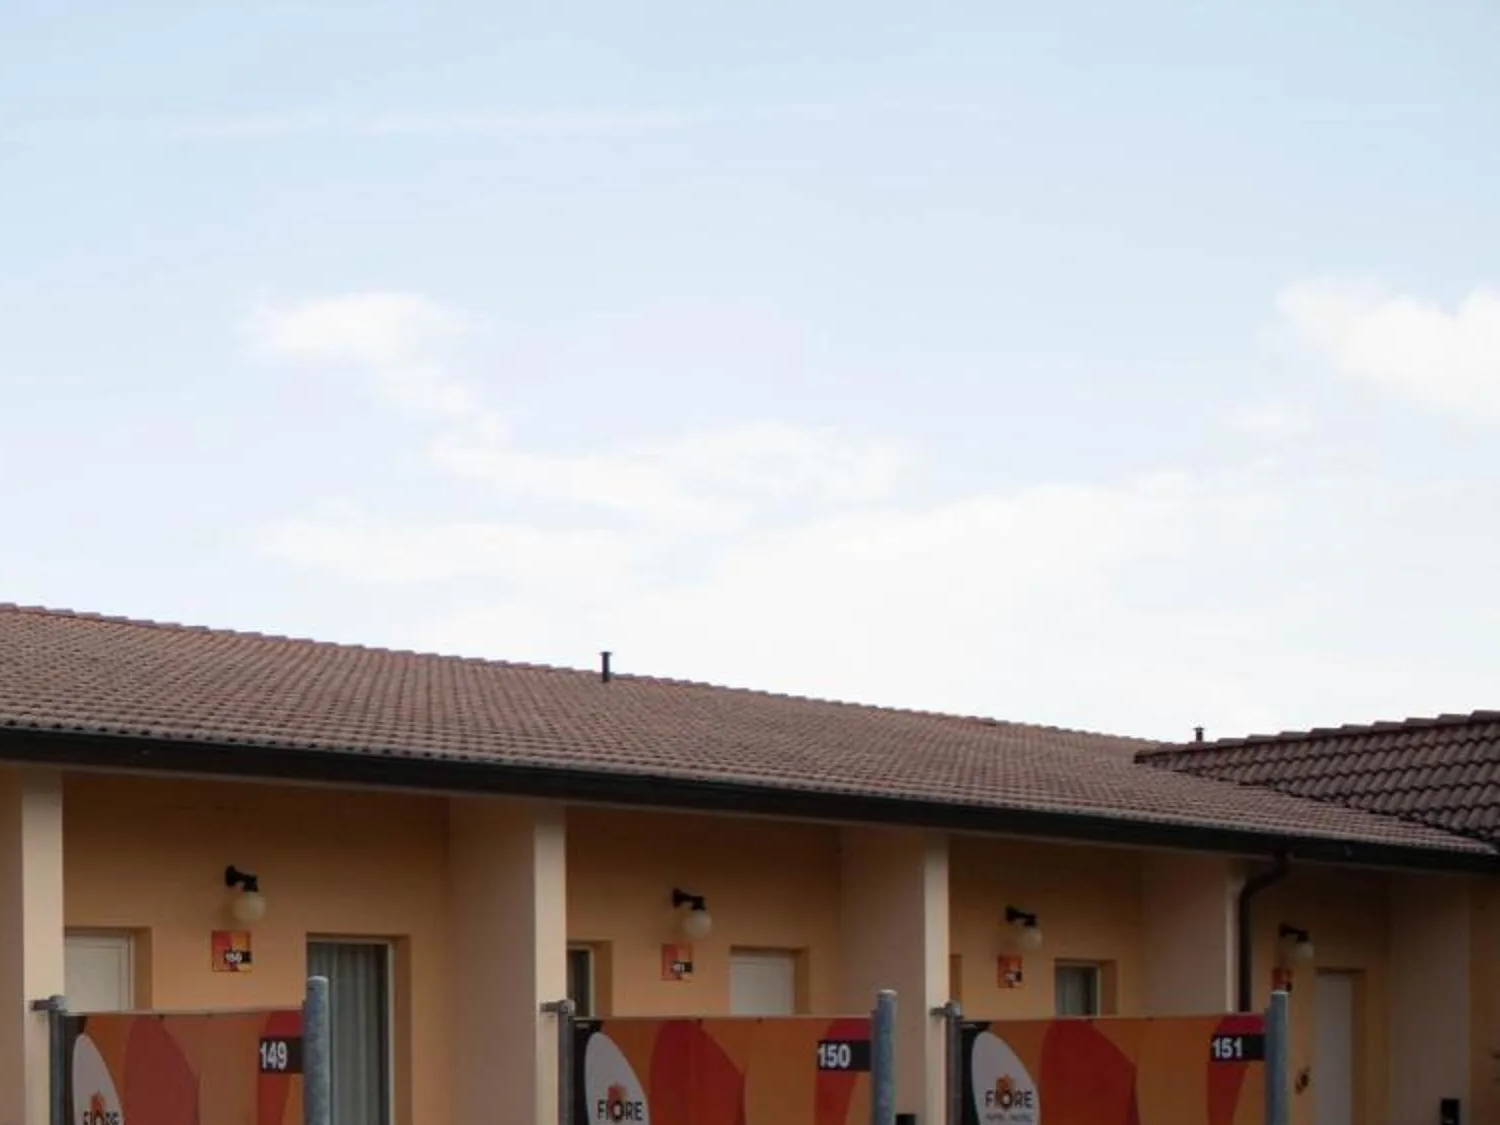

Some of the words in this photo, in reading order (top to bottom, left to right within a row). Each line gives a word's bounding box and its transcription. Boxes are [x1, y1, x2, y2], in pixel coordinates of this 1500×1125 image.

[260, 1041, 288, 1070] 149
[817, 1043, 852, 1069] 150
[1211, 1037, 1243, 1059] 151
[597, 1099, 644, 1124] FIORE
[984, 1089, 1033, 1112] FIORE
